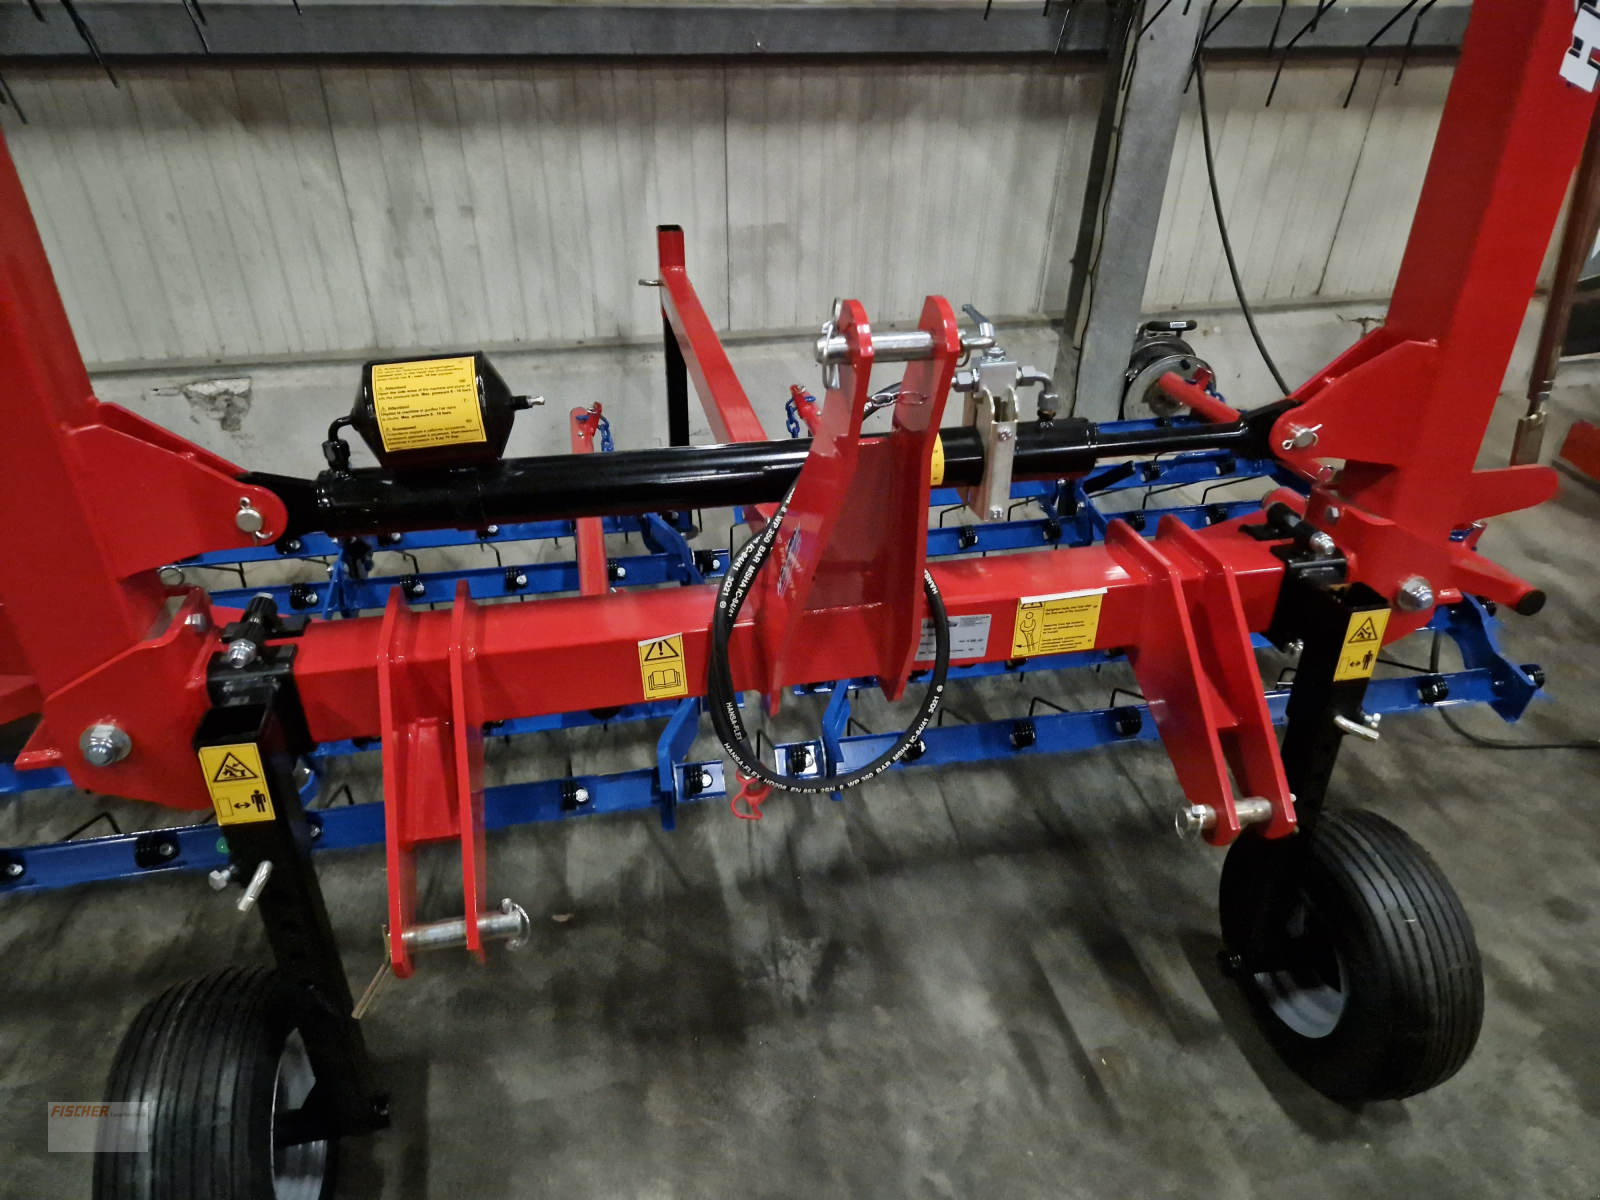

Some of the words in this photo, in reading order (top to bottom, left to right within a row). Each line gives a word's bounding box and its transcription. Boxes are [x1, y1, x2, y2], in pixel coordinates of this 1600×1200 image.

[772, 515, 784, 529] WP
[764, 528, 776, 543] 350
[732, 544, 756, 572] IC-84/41
[752, 545, 766, 563] BAR
[722, 575, 734, 597] 3Q21
[739, 565, 756, 589] MSHA
[726, 702, 744, 742] HANSA-FLEX
[724, 742, 762, 780] HANSA-FLEX
[847, 779, 860, 788] WP
[875, 760, 892, 774] BAR
[892, 743, 911, 762] MSHA
[909, 718, 930, 744] IC-84/41
[928, 695, 940, 714] 3Q21
